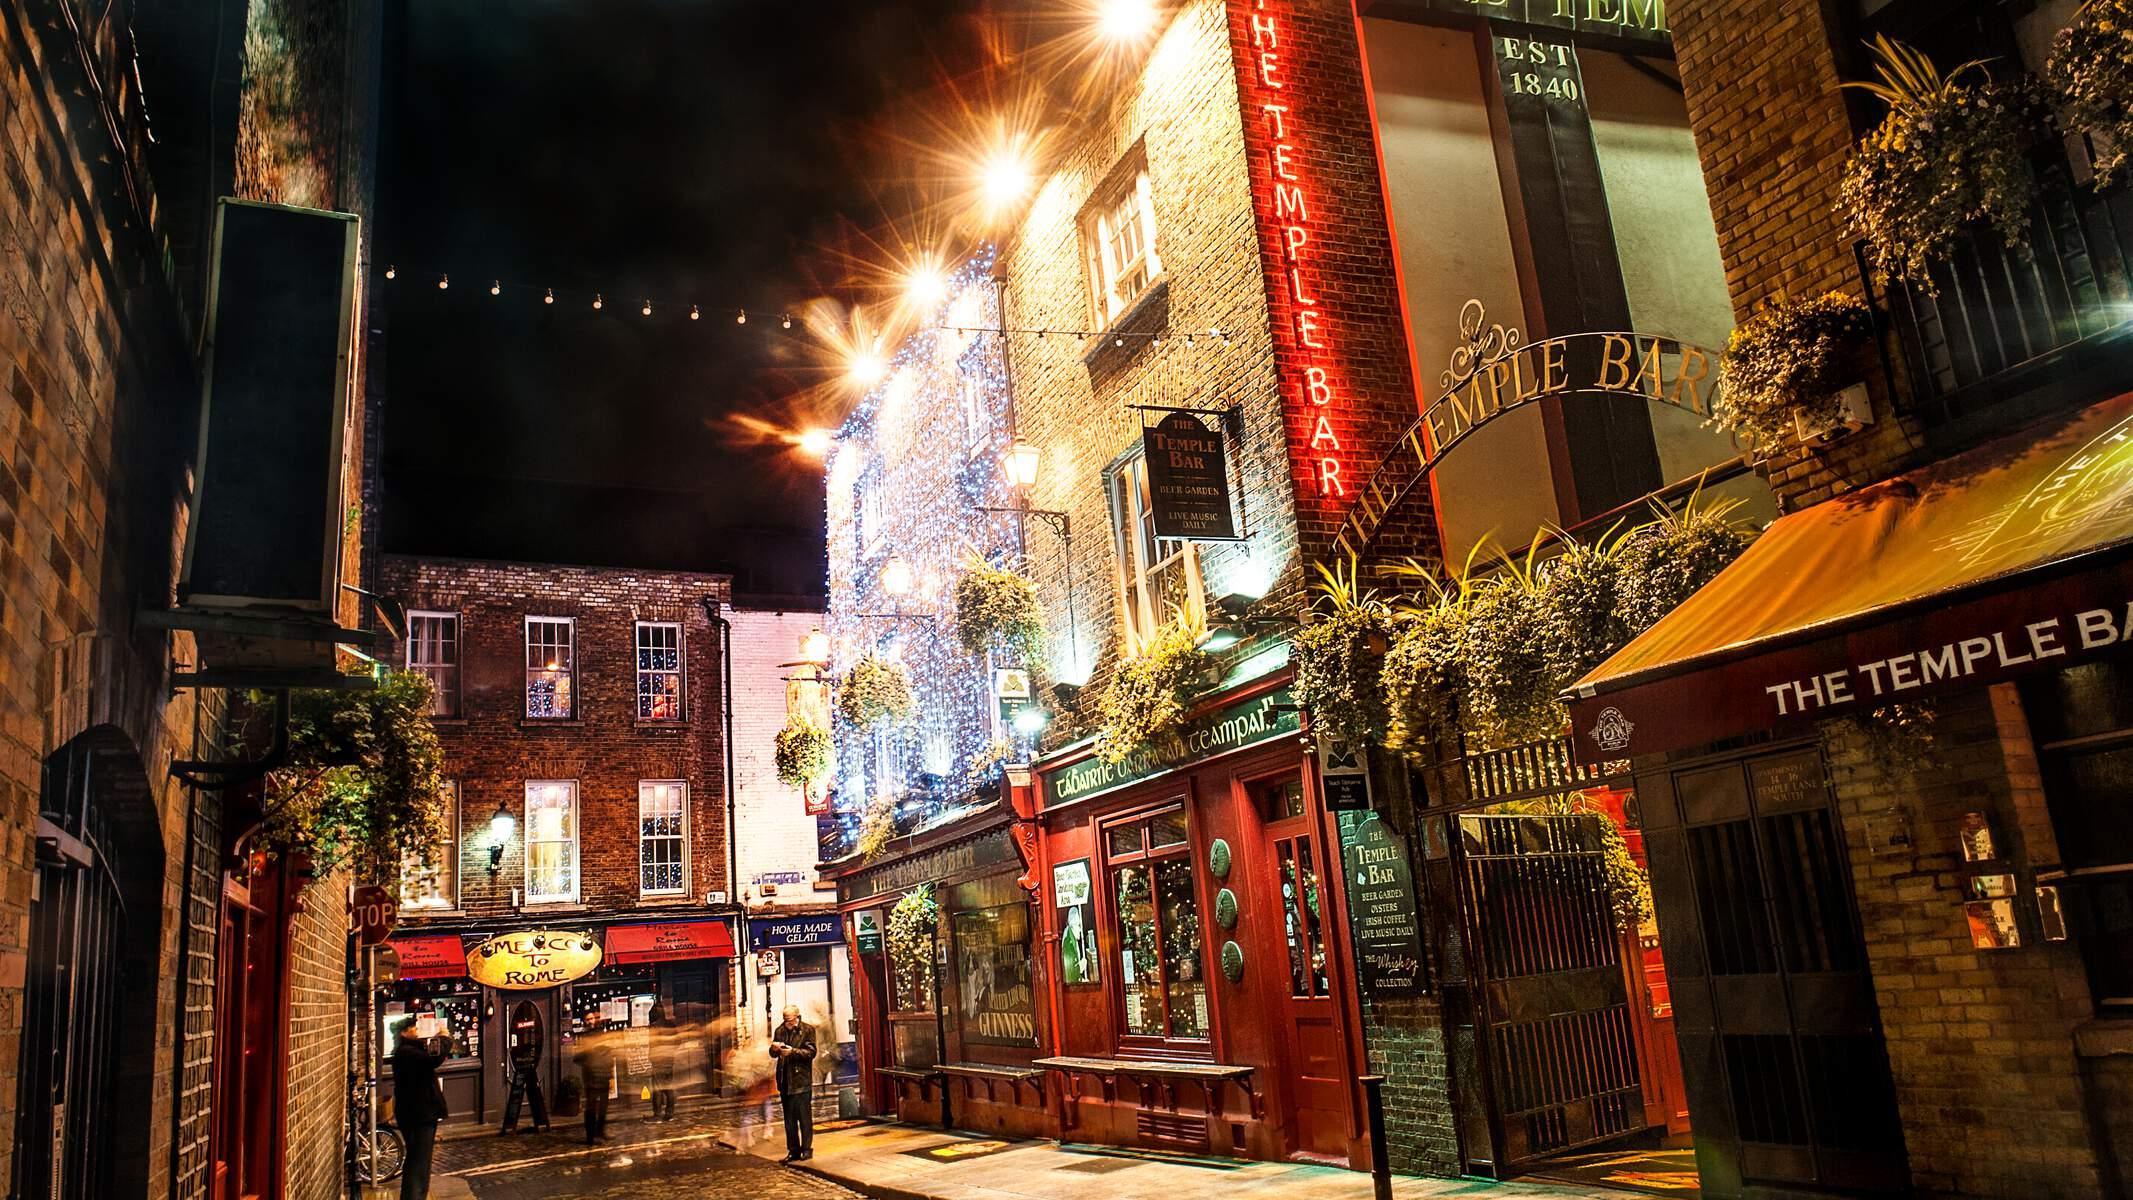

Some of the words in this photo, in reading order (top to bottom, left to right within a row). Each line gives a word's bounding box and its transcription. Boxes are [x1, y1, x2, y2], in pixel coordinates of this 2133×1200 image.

[1501, 37, 1570, 67] EST
[1510, 72, 1578, 101] 1840
[1264, 104, 1323, 347] TEMPLE
[1304, 367, 1345, 497] BAR
[1173, 420, 1195, 430] THE
[1153, 433, 1217, 453] TEMPLE
[1331, 466, 1398, 557] THE
[1401, 338, 1569, 470] TEMPLE
[1593, 334, 1710, 416] BAR
[1169, 451, 1205, 469] BAR
[2027, 453, 2104, 510] THE
[1160, 485, 1182, 494] BEER
[1184, 486, 1219, 496] GARDEN
[1168, 511, 1187, 520] LIVE
[1190, 512, 1218, 521] MUSIC
[1182, 521, 1207, 530] DAILY
[1765, 668, 1855, 716] THE
[1858, 616, 2067, 697] TEMPLE
[2074, 600, 2133, 650] B
[1369, 831, 1383, 842] THE
[1356, 845, 1399, 865] TEMPLE
[870, 866, 893, 895] THE
[946, 845, 974, 873] BAR
[1368, 865, 1396, 886] BAR
[1361, 891, 1378, 902] BEER
[1378, 888, 1404, 900] GARDEN
[1370, 902, 1398, 914] OYSTERS
[1365, 916, 1383, 926] IRISH
[1383, 914, 1407, 925] COFFEE
[771, 925, 801, 936] HOME
[803, 922, 833, 933] MADE
[1361, 929, 1375, 939] LIVE
[1376, 928, 1395, 938] MUSIC
[1396, 926, 1415, 936] DAILY
[493, 938, 577, 954] MECO
[753, 938, 760, 946] 1
[786, 932, 818, 944] GELATI
[1365, 954, 1377, 963] THE
[1376, 953, 1419, 977] Whiskey
[504, 968, 570, 986] ROME
[1375, 977, 1413, 988] COLLECTION
[979, 1011, 1034, 1039] GUINNESS
